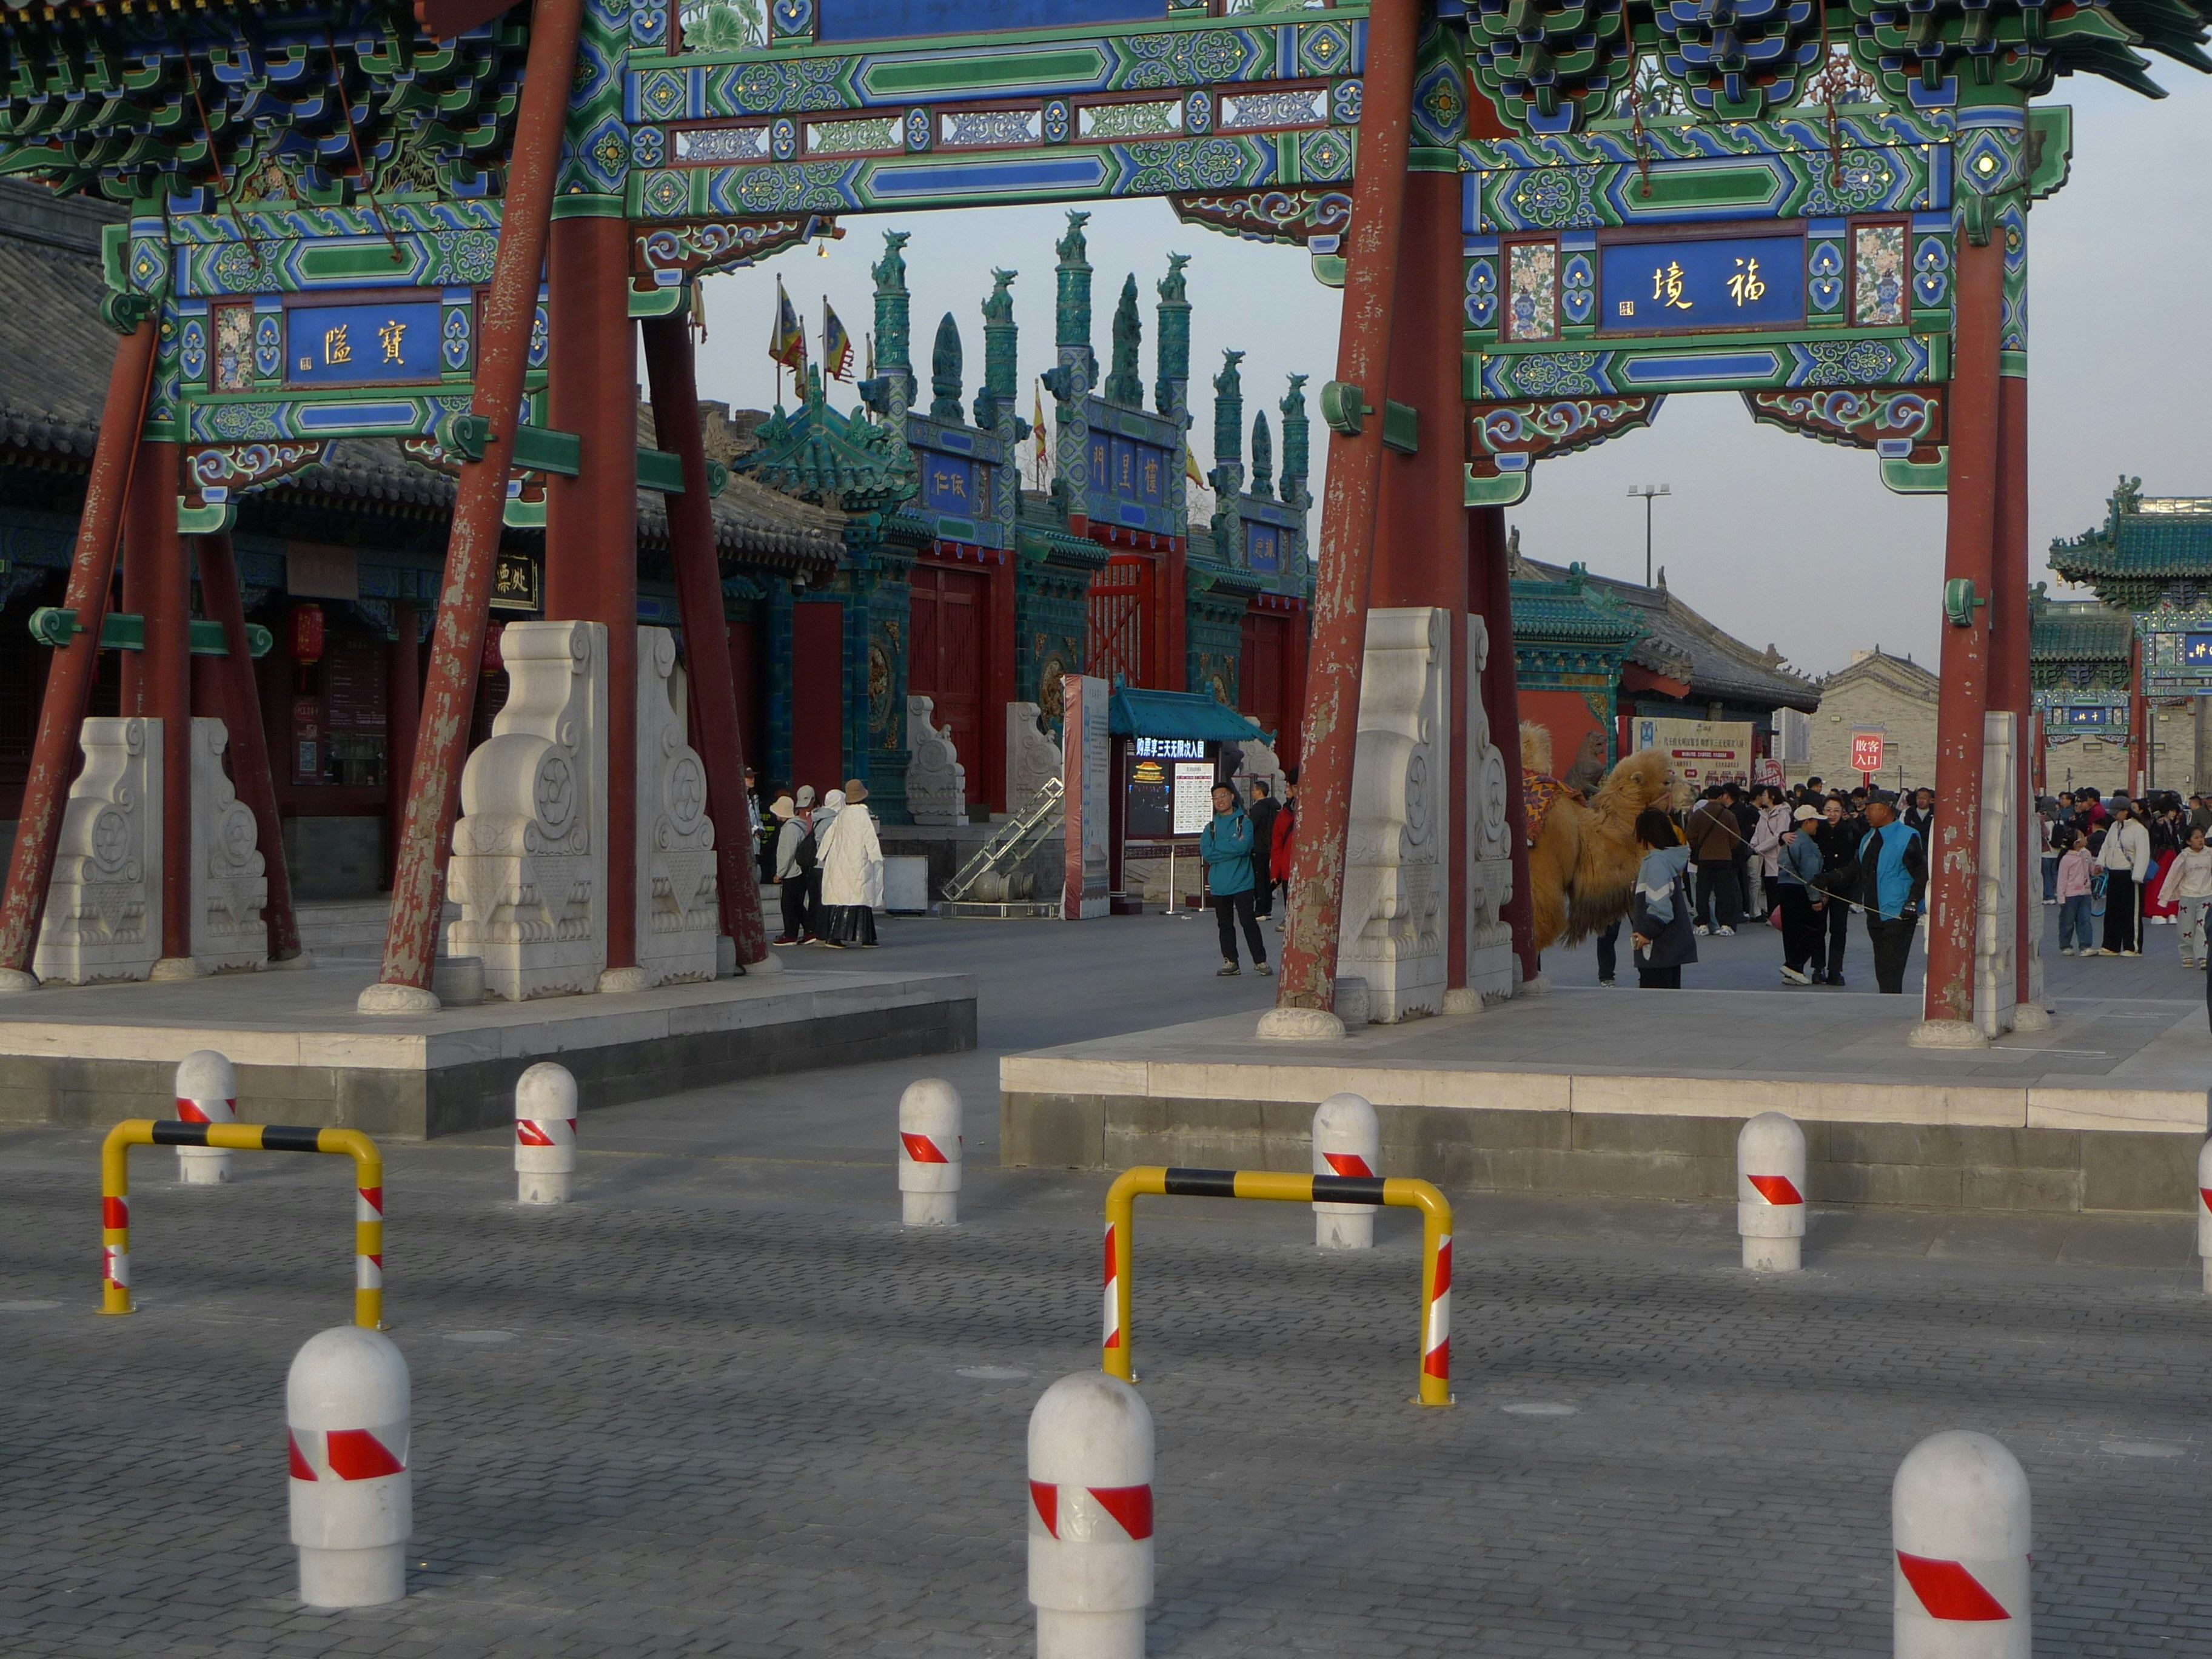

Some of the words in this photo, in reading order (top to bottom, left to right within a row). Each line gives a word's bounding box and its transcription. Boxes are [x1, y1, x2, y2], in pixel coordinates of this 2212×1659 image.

[1136, 737, 1204, 759] 购票享三天无限次入园
[1855, 739, 1879, 752] 散客
[1855, 754, 1877, 766] 入口
